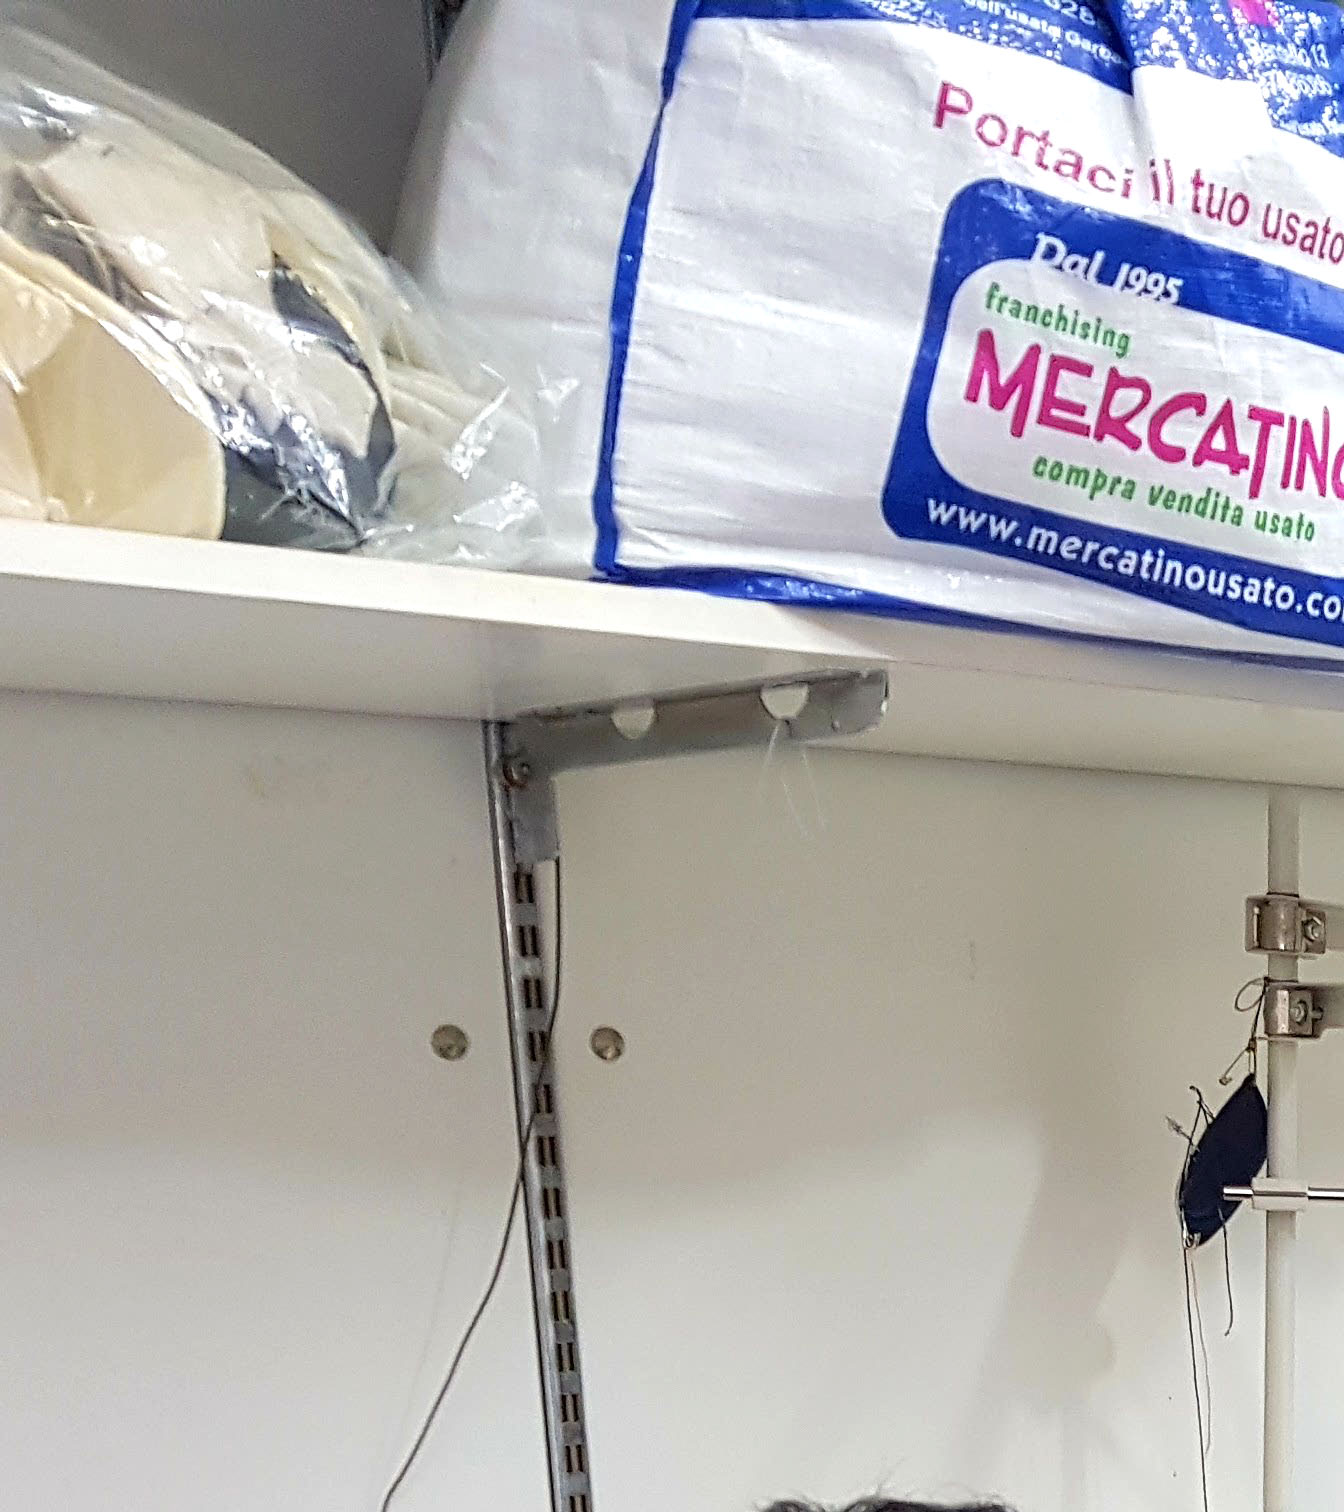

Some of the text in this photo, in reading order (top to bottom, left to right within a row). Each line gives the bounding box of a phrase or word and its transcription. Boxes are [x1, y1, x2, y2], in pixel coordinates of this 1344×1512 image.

[934, 80, 1133, 199] Portaci
[1149, 158, 1175, 205] il
[1191, 169, 1250, 227] tuo
[1031, 231, 1184, 305] Dal 1995
[984, 281, 1132, 359] franchising
[1032, 454, 1316, 542] compra vendita usato
